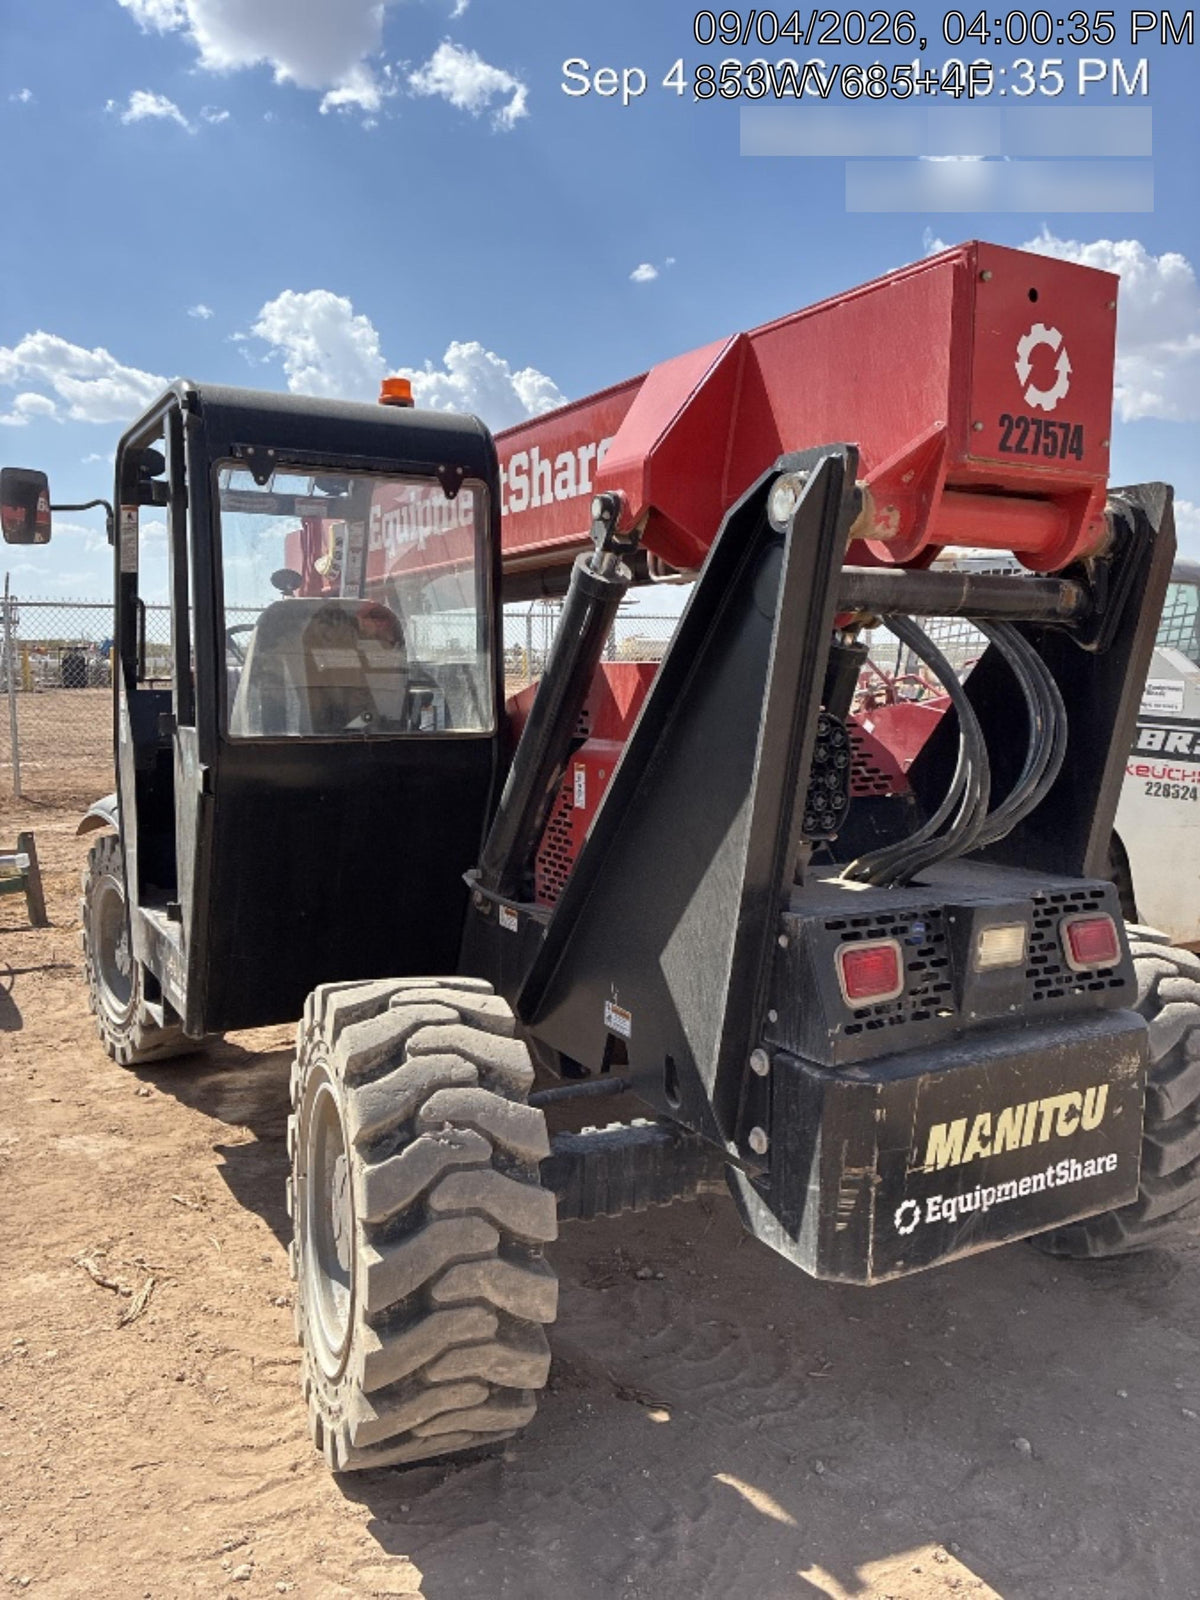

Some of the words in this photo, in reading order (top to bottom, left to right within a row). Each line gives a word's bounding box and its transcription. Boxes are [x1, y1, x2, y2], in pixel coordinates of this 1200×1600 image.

[997, 413, 1085, 461] 227574
[923, 1084, 1109, 1174] MANITOU
[925, 1152, 1118, 1223] EquipmentShare
